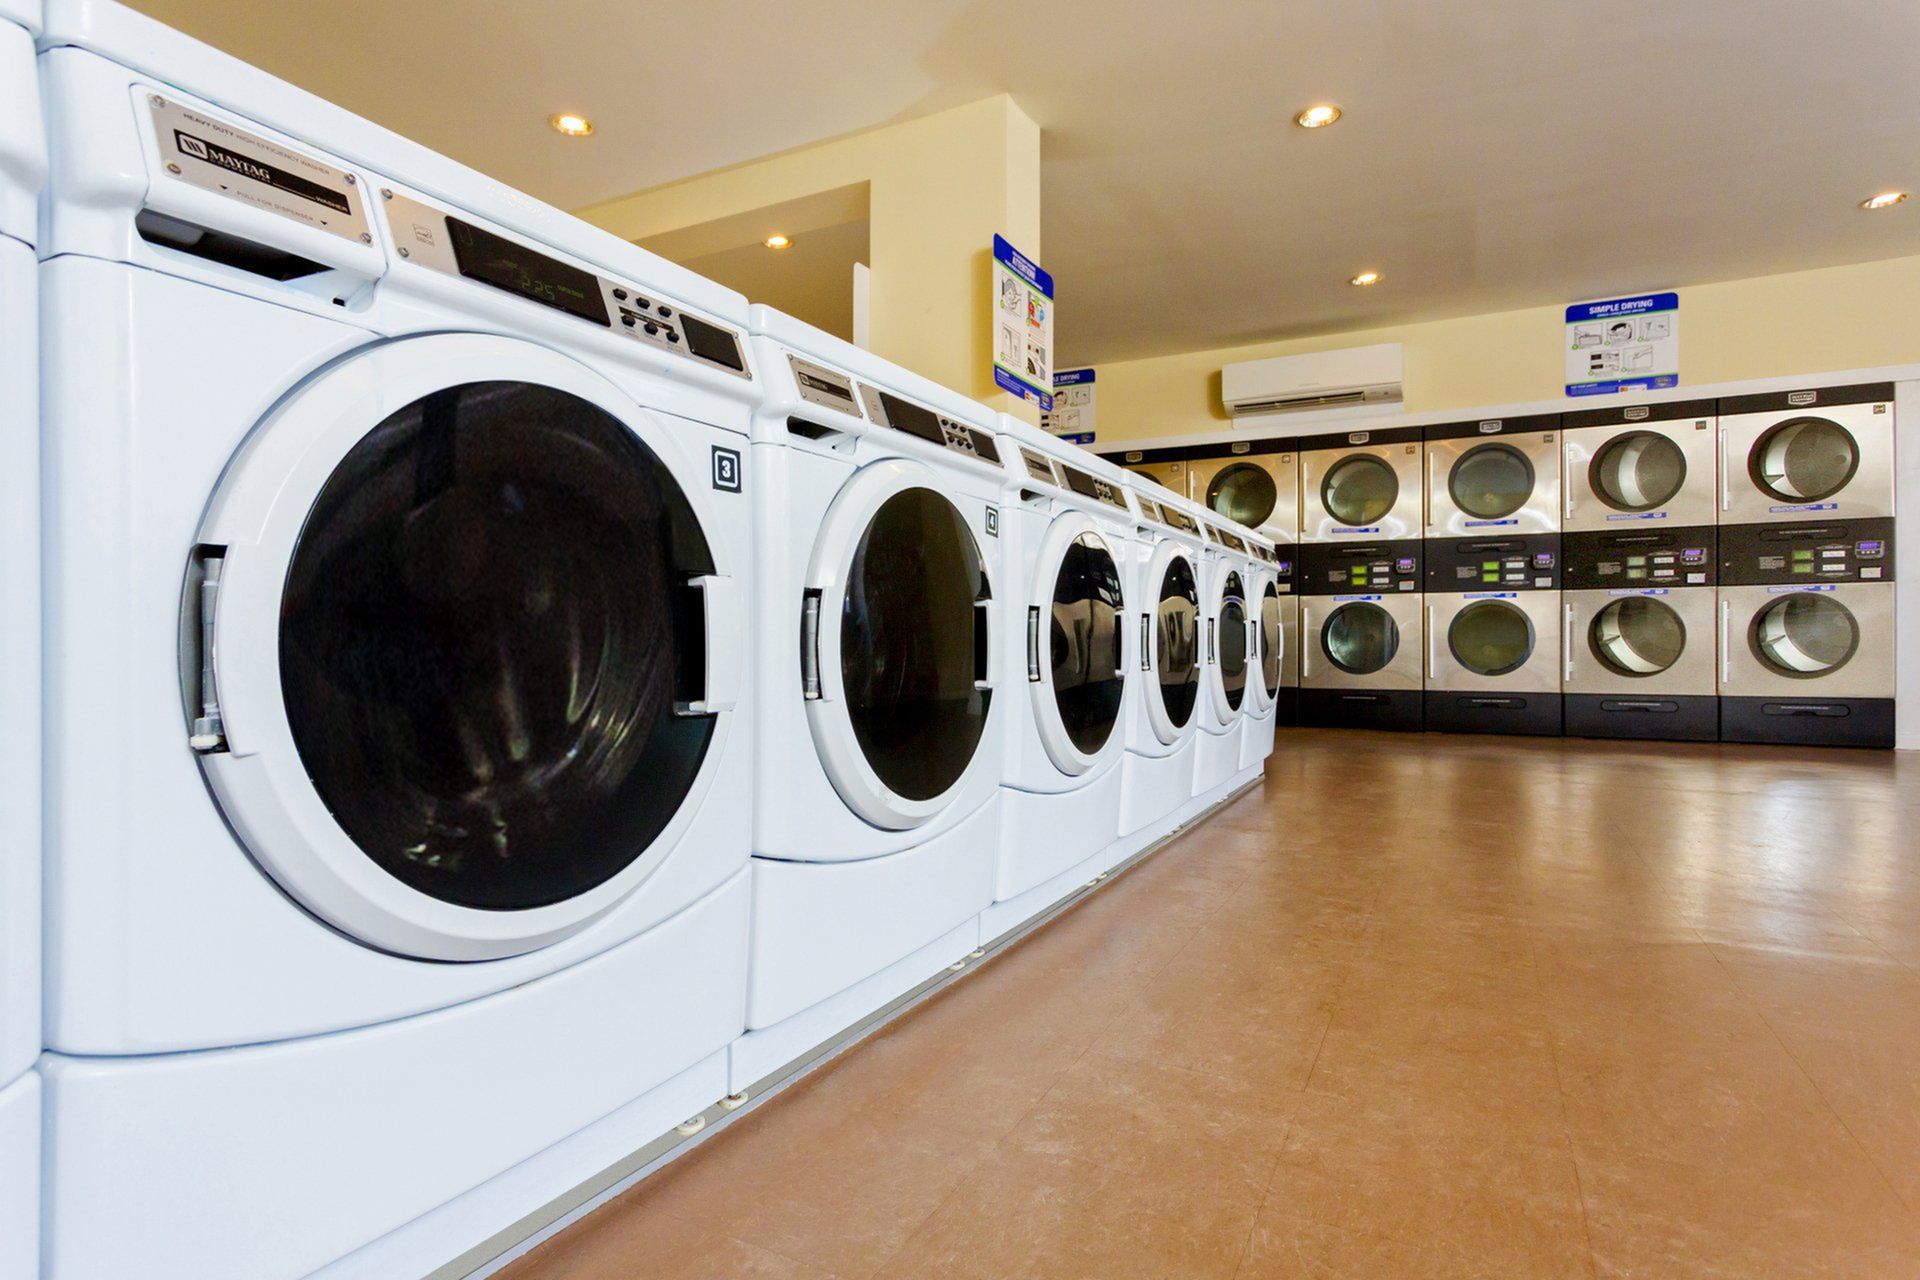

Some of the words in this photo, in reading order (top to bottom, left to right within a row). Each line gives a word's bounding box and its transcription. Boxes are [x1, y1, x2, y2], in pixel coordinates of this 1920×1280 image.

[183, 112, 211, 127] HEAVY
[212, 123, 235, 137] DUTY
[208, 149, 271, 180] MAYTAG
[1589, 303, 1620, 315] SIMPLE
[1621, 299, 1654, 311] DRYING
[721, 459, 731, 478] 3
